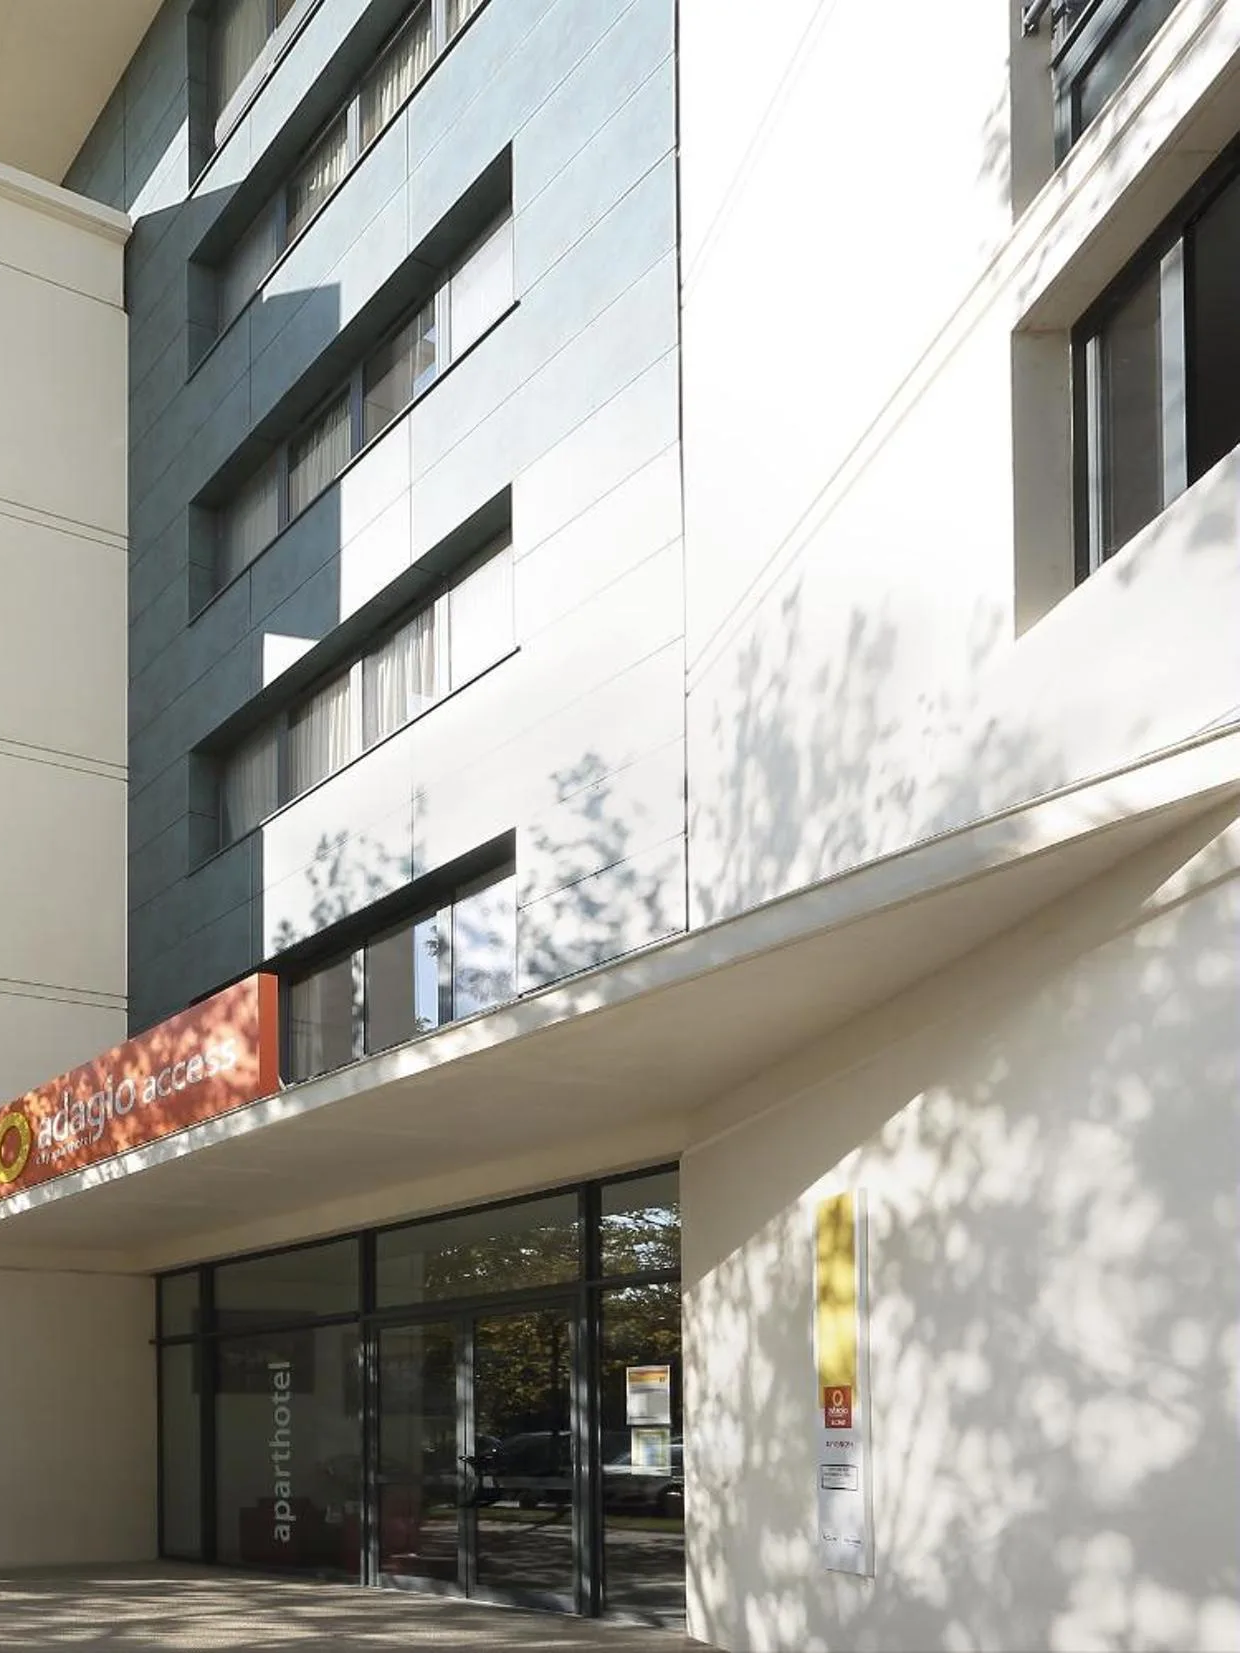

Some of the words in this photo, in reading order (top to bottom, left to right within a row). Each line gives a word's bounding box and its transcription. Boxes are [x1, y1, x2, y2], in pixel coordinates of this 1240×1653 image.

[37, 1074, 136, 1148] adagio
[141, 1037, 237, 1104] access
[268, 1361, 296, 1542] aparthotel
